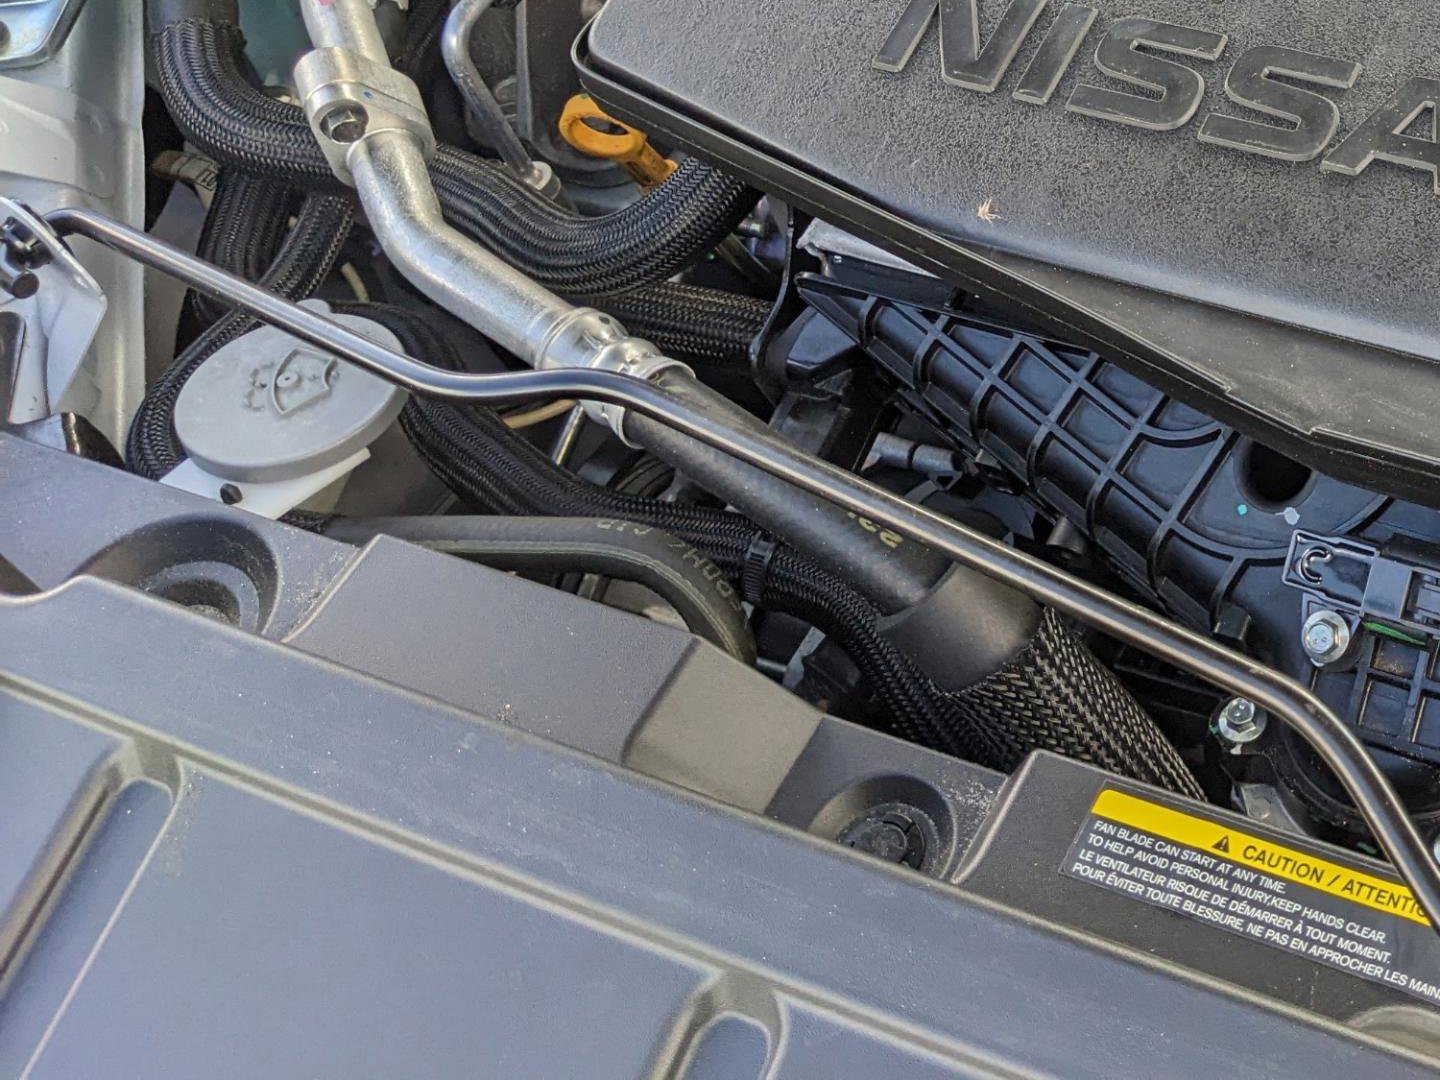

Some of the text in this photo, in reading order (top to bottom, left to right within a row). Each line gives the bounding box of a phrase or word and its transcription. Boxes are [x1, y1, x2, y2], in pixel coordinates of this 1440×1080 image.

[1087, 832, 1105, 847] TO
[1103, 837, 1135, 855] HELP
[1133, 849, 1170, 870] AVOID
[1169, 861, 1230, 891] PERSONAL
[1301, 907, 1345, 931] HANDS
[1093, 819, 1117, 837] FAN
[1116, 827, 1155, 850] BLADE
[1154, 840, 1181, 858] CAN
[1180, 849, 1219, 870] START
[1215, 862, 1233, 875] AT
[1231, 867, 1258, 883] ANY
[1243, 845, 1325, 884] CAUTION
[1072, 862, 1107, 882] POUR
[1105, 870, 1146, 896] ÉVITER
[1144, 886, 1183, 908] TOUTE
[1182, 899, 1245, 932] BLESSURE,
[1246, 922, 1265, 938] NE
[1263, 929, 1290, 946] PAS
[1289, 937, 1311, 953] EN
[1309, 944, 1385, 978] APPROCHER
[1383, 968, 1409, 987] LES
[1078, 848, 1393, 965] LE VENTILATEUR RISQUE DE DÉMARRER À TOUT MOMENT.
